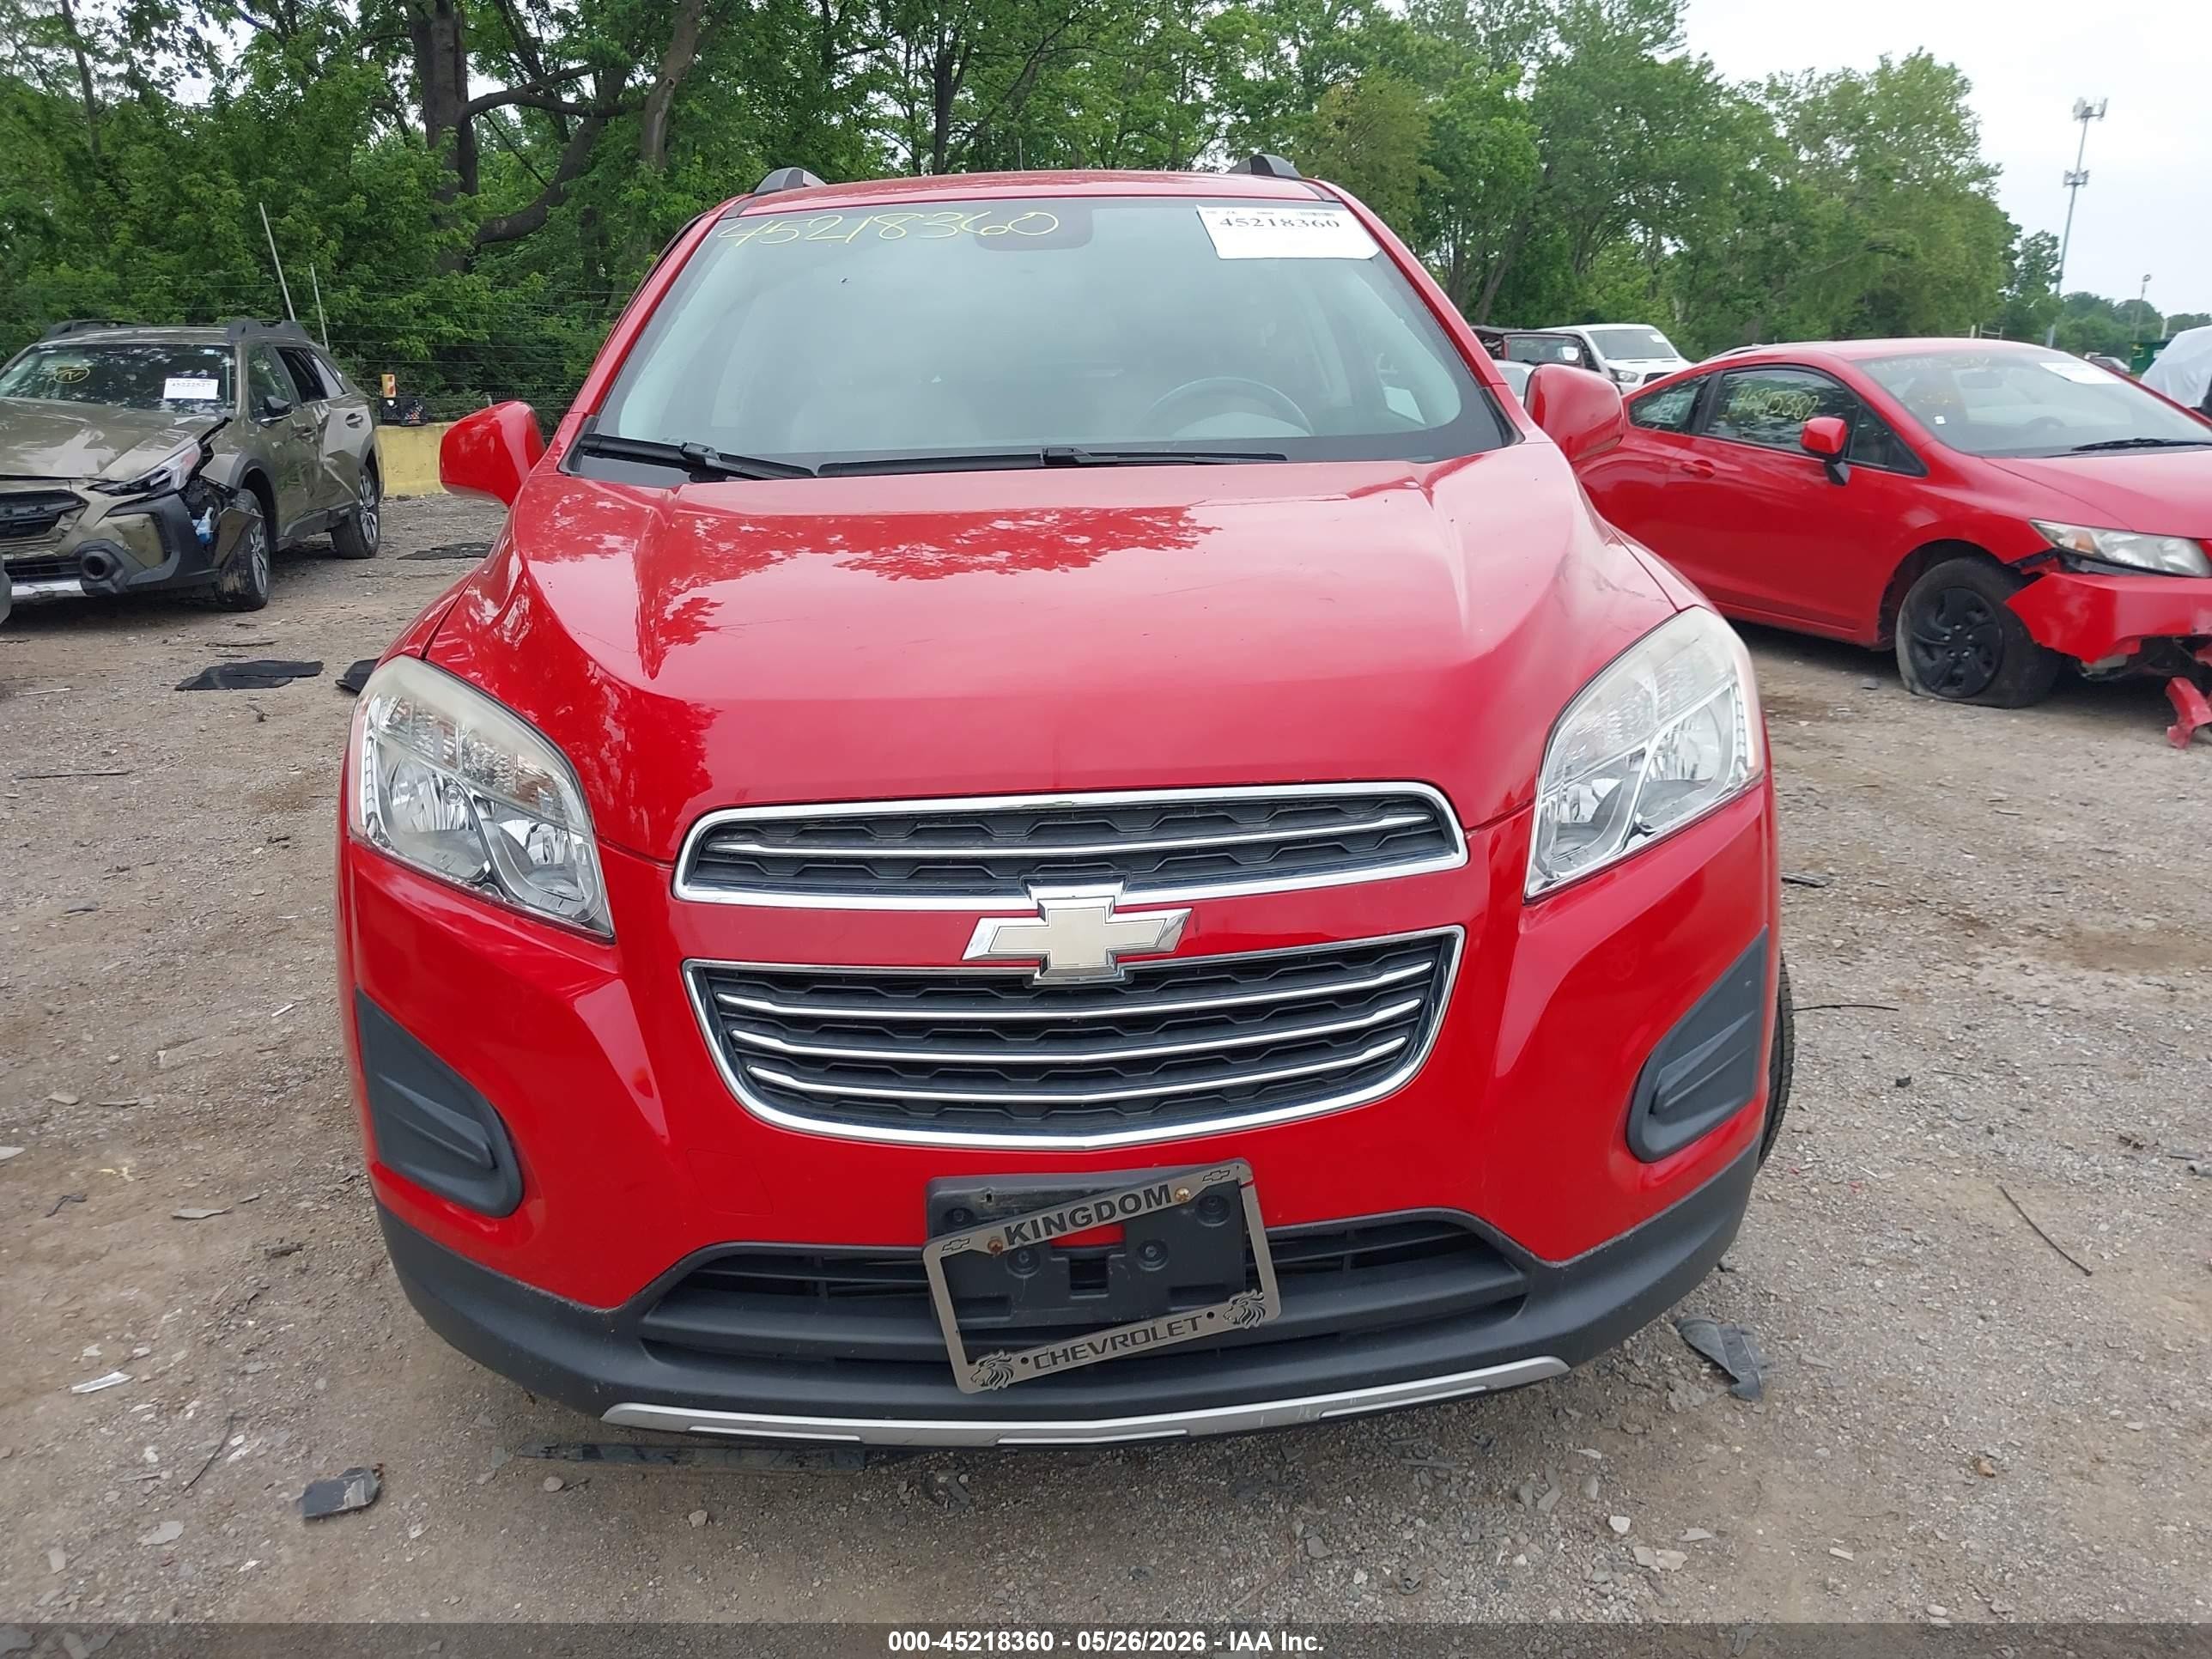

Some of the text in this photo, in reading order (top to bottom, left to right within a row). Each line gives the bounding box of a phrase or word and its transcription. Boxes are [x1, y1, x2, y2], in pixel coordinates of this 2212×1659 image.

[718, 211, 1059, 246] 45218360
[1219, 217, 1340, 228] 45218360
[1003, 1184, 1172, 1247] KINGDOM
[1033, 1316, 1202, 1371] CHEVROLET
